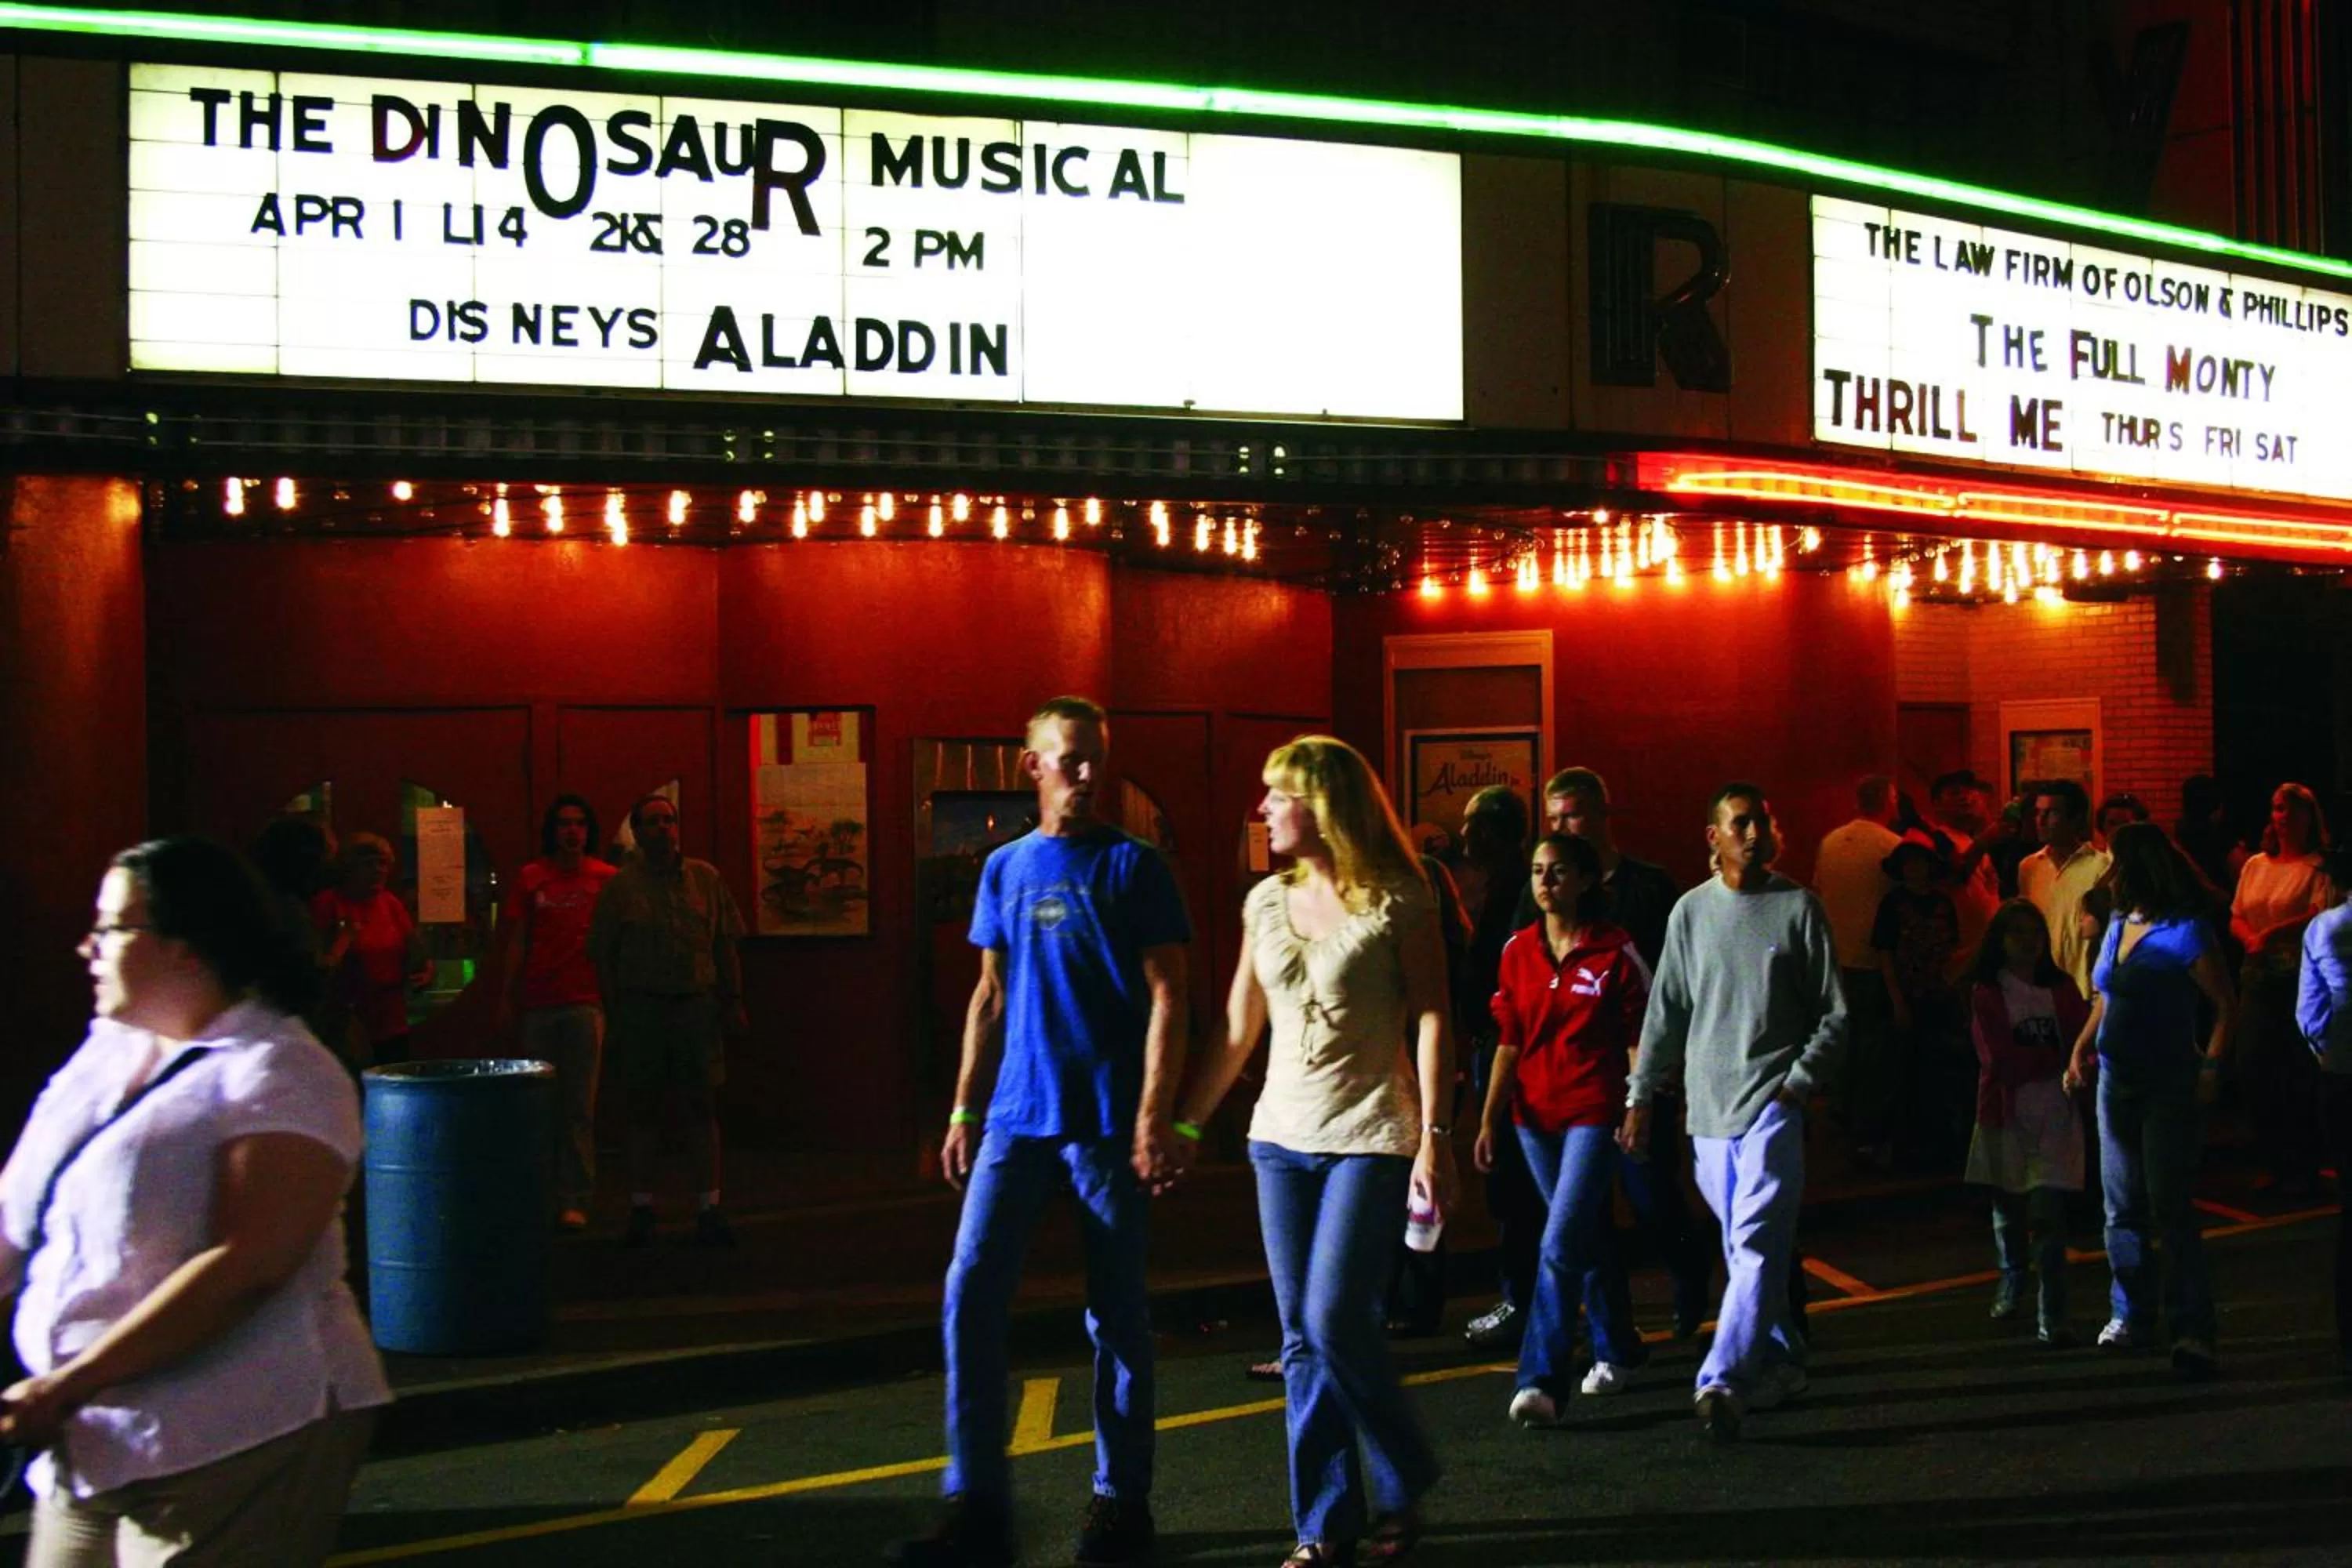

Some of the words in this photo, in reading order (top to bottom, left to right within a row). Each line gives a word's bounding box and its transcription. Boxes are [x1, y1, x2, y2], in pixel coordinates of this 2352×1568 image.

[190, 87, 334, 153] THE
[372, 93, 826, 235] DINOSAUR
[870, 132, 1185, 204] MUSICAL
[691, 214, 751, 257] 28
[862, 227, 891, 268] 2
[913, 229, 985, 270] PM
[1864, 223, 1921, 265] THE
[1933, 235, 1995, 278] LAW
[2005, 249, 2074, 292] FIRM
[2082, 263, 2118, 301] OF
[2124, 271, 2210, 314] OLSON
[2219, 287, 2234, 320] &
[2242, 290, 2350, 337] PHILLIPS
[409, 298, 659, 350] DISNEYS
[692, 304, 1008, 377] ALADDIN
[1969, 314, 2048, 373] THE
[2069, 328, 2147, 386] FULL
[2165, 345, 2277, 403] MONTY
[1823, 368, 1978, 444] THRILL
[2009, 394, 2064, 452] ME
[2101, 411, 2184, 452] THURS
[2204, 426, 2243, 459] FRI
[2255, 433, 2299, 465] SAT
[1420, 761, 1509, 797] Aladdin
